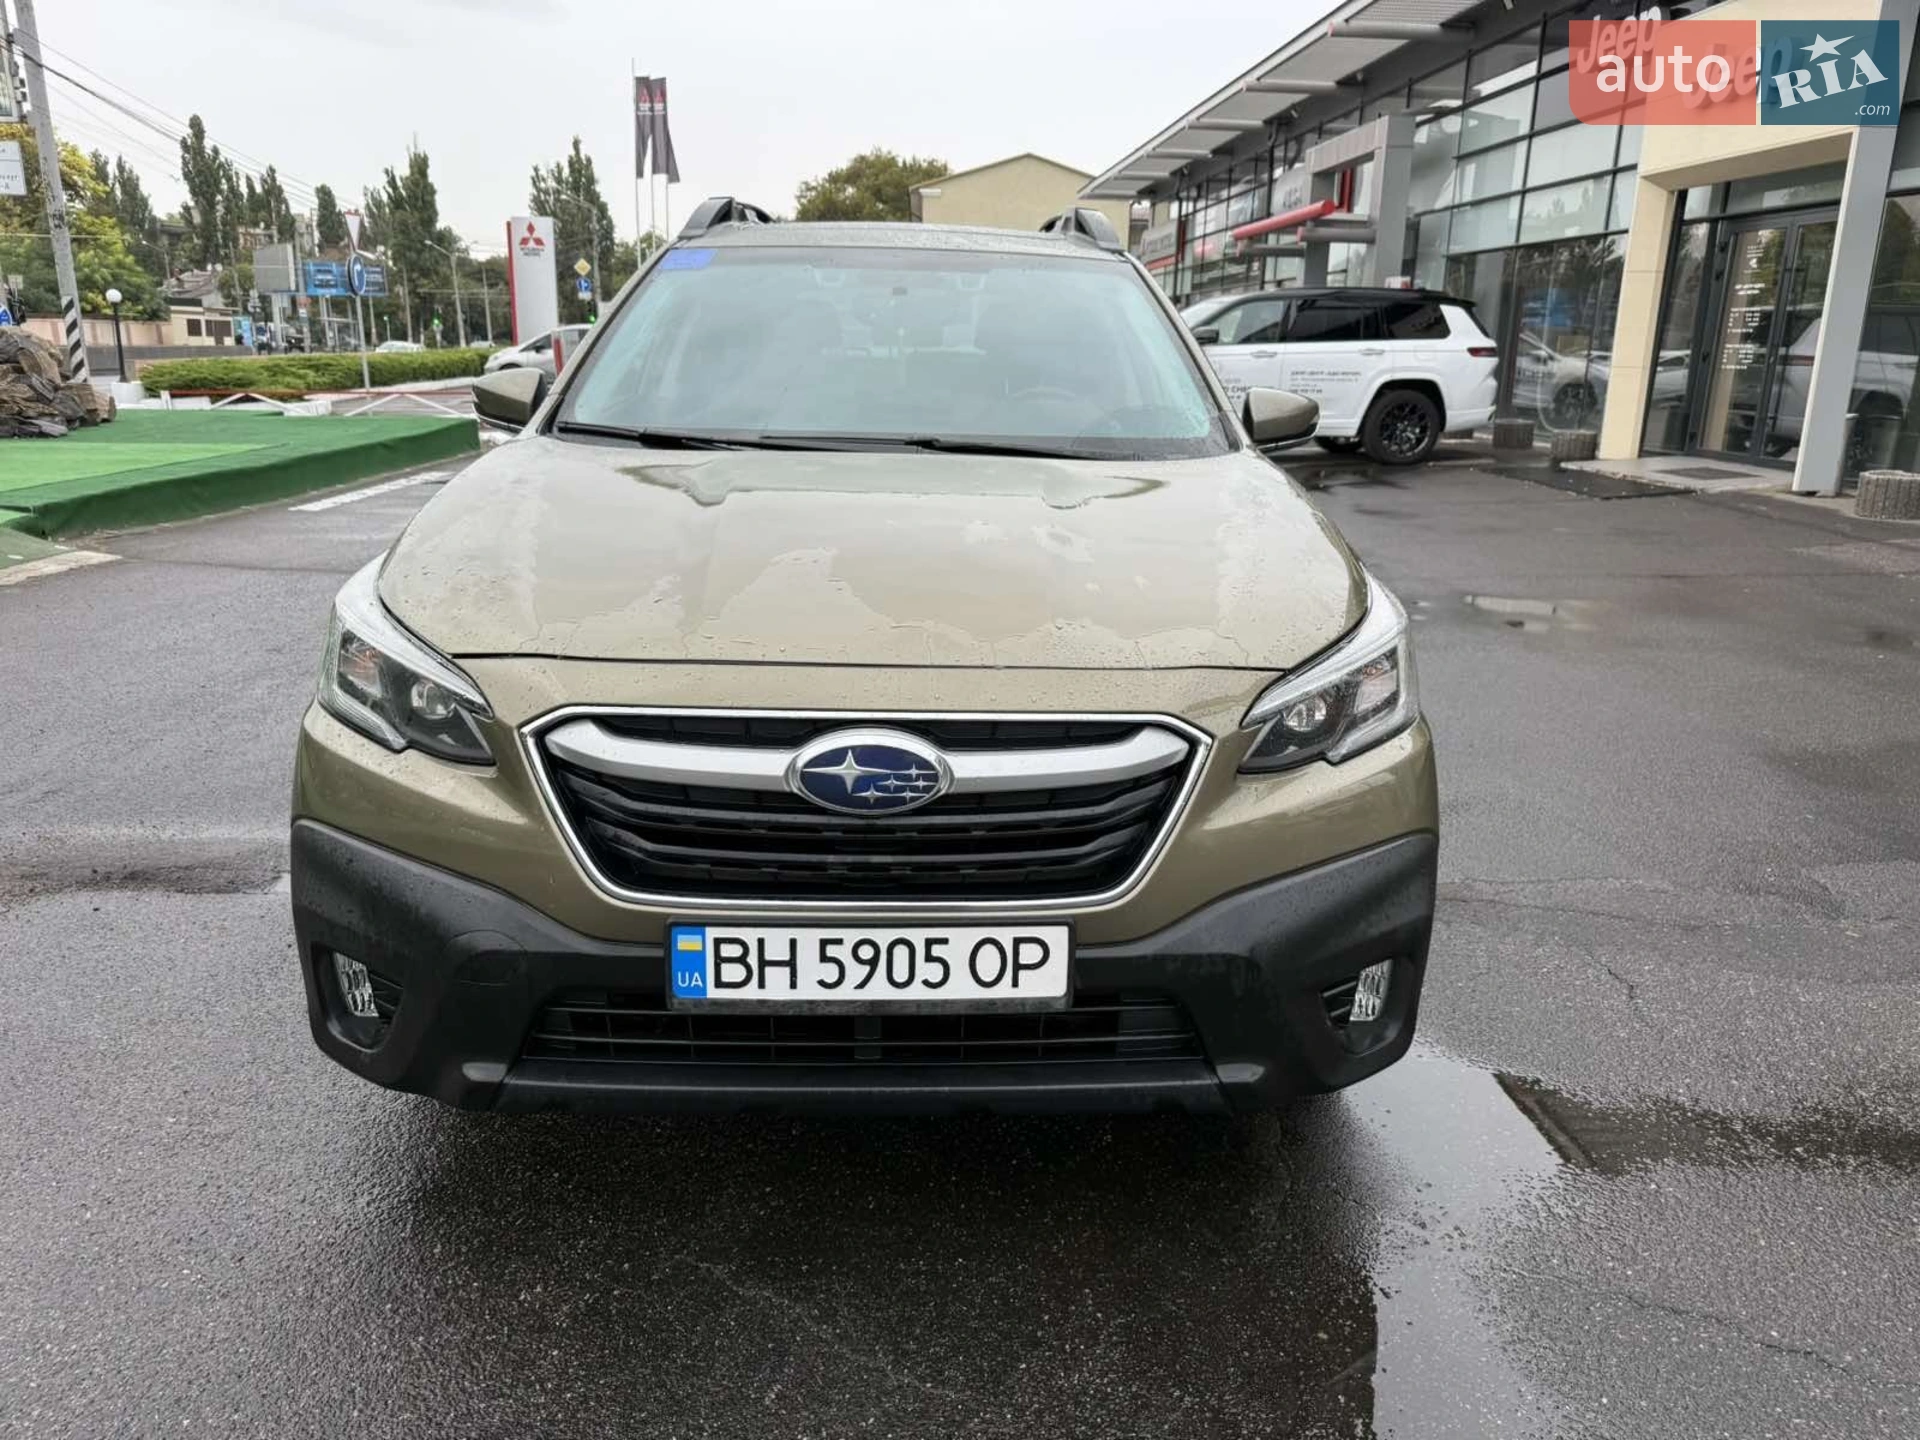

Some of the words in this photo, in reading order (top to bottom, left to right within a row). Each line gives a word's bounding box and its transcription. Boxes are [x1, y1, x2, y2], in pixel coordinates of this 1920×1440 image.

[1577, 6, 1661, 74] Jeep
[677, 970, 703, 988] UA
[712, 936, 798, 990] BH
[816, 936, 951, 990] 5905
[968, 935, 1051, 989] OP
